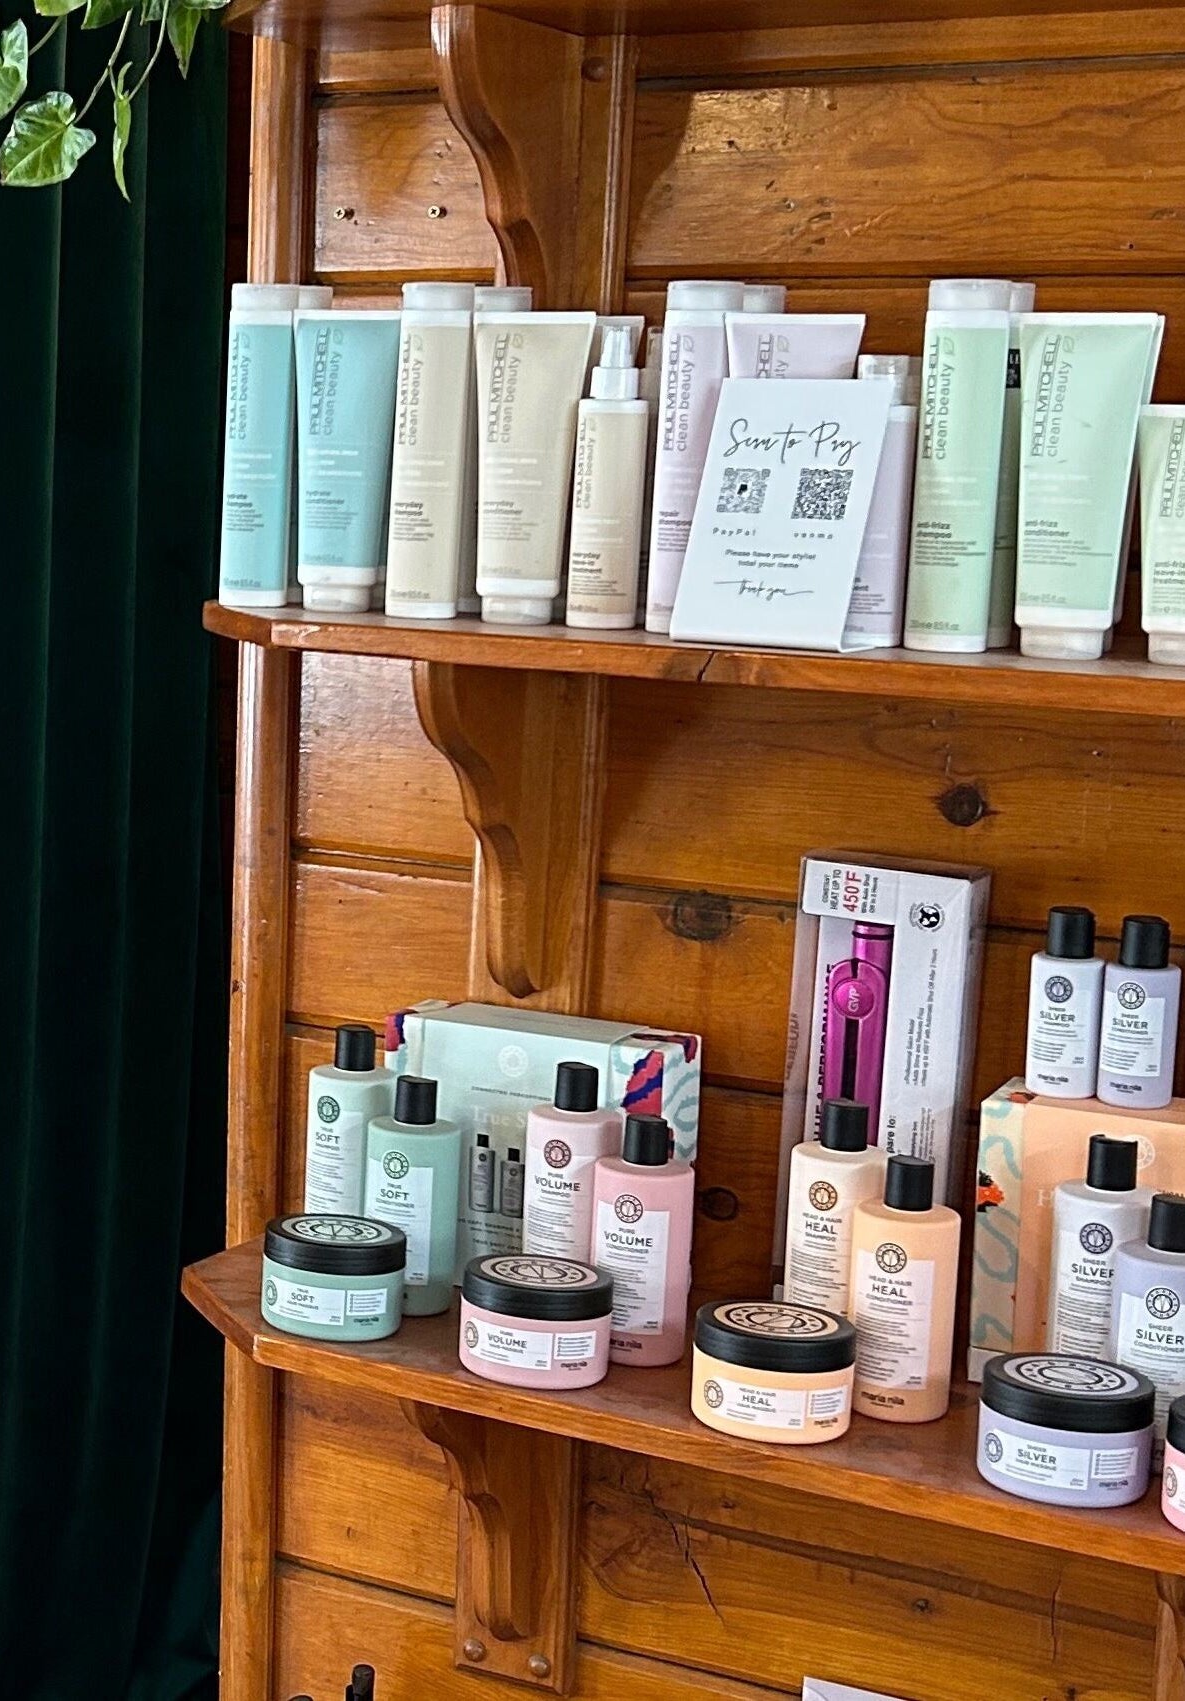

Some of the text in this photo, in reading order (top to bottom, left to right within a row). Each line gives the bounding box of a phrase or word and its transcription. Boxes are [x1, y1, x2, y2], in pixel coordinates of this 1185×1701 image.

[756, 333, 773, 378] CHELL
[238, 355, 251, 440] clean beauty
[324, 351, 342, 436] clean beauty
[408, 358, 423, 446] clean beauty
[500, 356, 521, 443] clean beauty
[922, 336, 940, 459] PAUL MITCHELL
[1031, 335, 1061, 457] PAUL MITCHELL
[676, 360, 695, 452] clean beauty
[935, 363, 955, 460] clean beauty
[1047, 361, 1073, 457] clean beauty
[773, 423, 808, 464] to
[808, 420, 862, 467] Pay
[772, 552, 790, 560] your
[830, 868, 842, 911] HEAT UP TO
[848, 986, 861, 1013] GVP
[1039, 1010, 1076, 1023] SILVER
[1112, 1017, 1149, 1030] SILVER
[315, 1131, 340, 1145] SOFT
[534, 1175, 581, 1192] VOLUME
[380, 1188, 410, 1201] SOFT
[805, 1220, 838, 1235] HEAL
[604, 1230, 654, 1248] VOLUME
[805, 1231, 837, 1242] SHAMPOO
[291, 1292, 315, 1303] SOFT
[866, 1293, 914, 1306] CONDITIONER
[871, 1284, 908, 1299] HEAL
[487, 1332, 528, 1349] VOLUME
[1135, 1328, 1185, 1346] SILVER
[742, 1394, 772, 1407] HEAL
[861, 1390, 905, 1406] maria nila
[1017, 1448, 1057, 1465] SILVER
